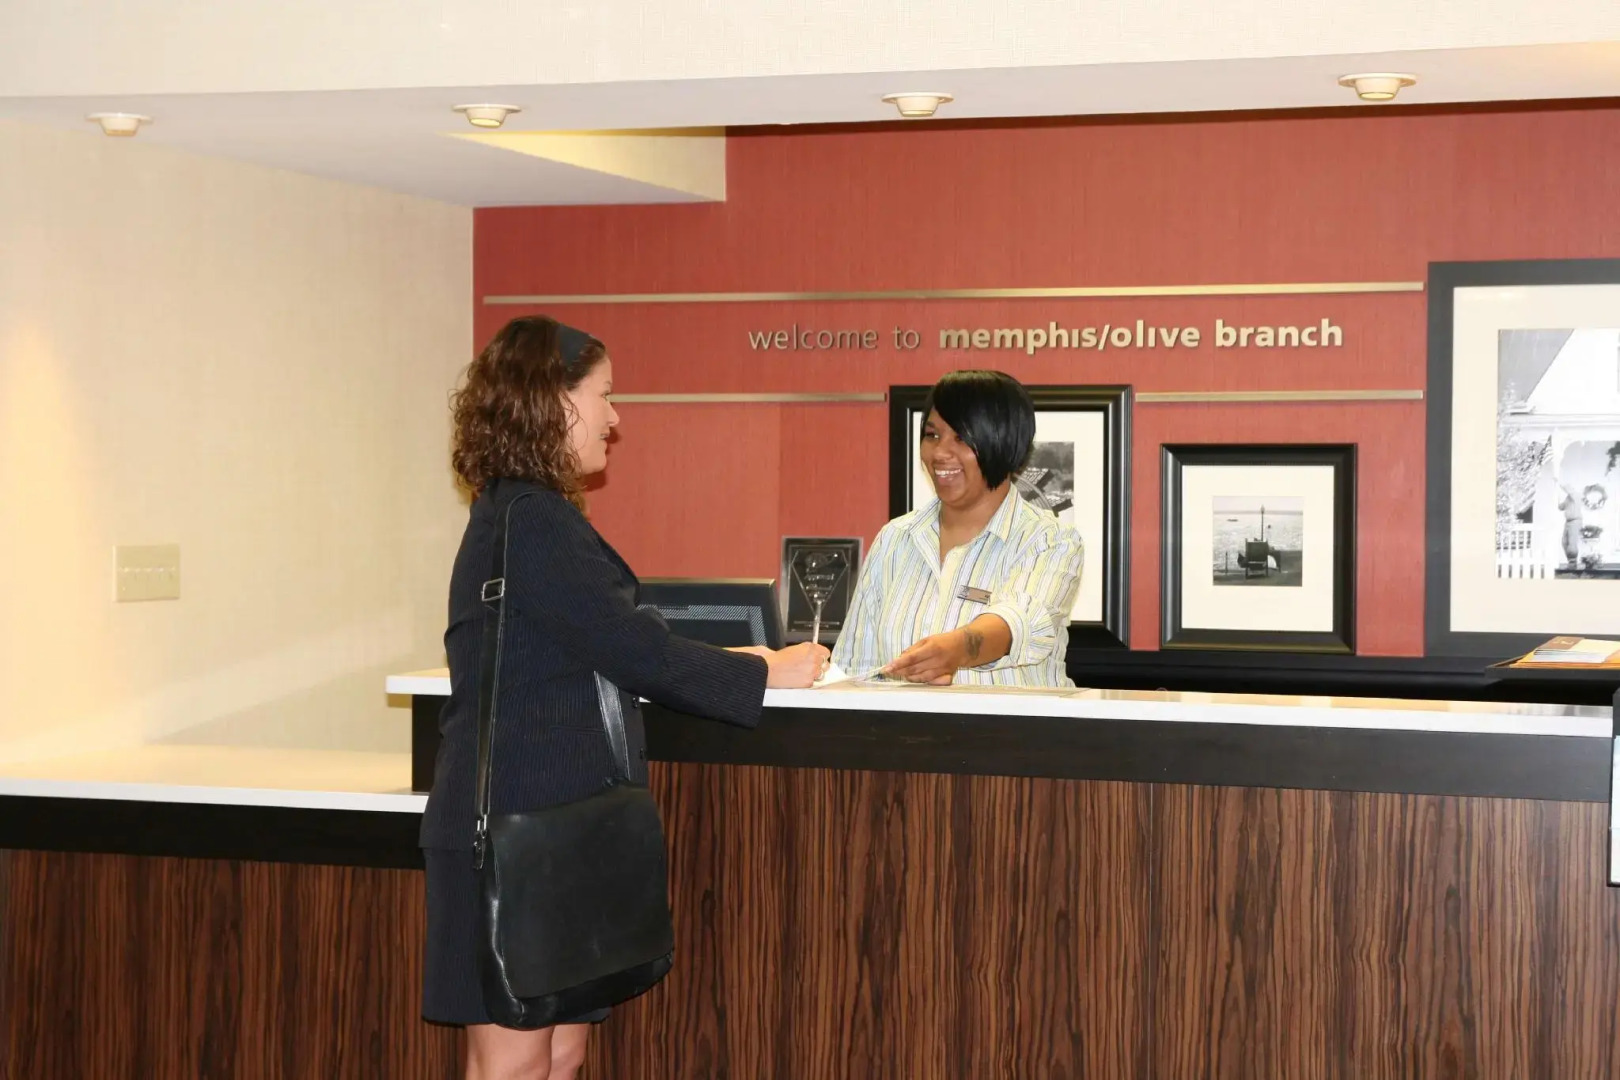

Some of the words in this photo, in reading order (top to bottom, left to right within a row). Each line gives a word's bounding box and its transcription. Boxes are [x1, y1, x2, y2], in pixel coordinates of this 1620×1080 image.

[748, 323, 879, 350] welcome
[892, 325, 921, 350] to
[938, 319, 1201, 354] memphis/olive
[1215, 318, 1343, 348] branch
